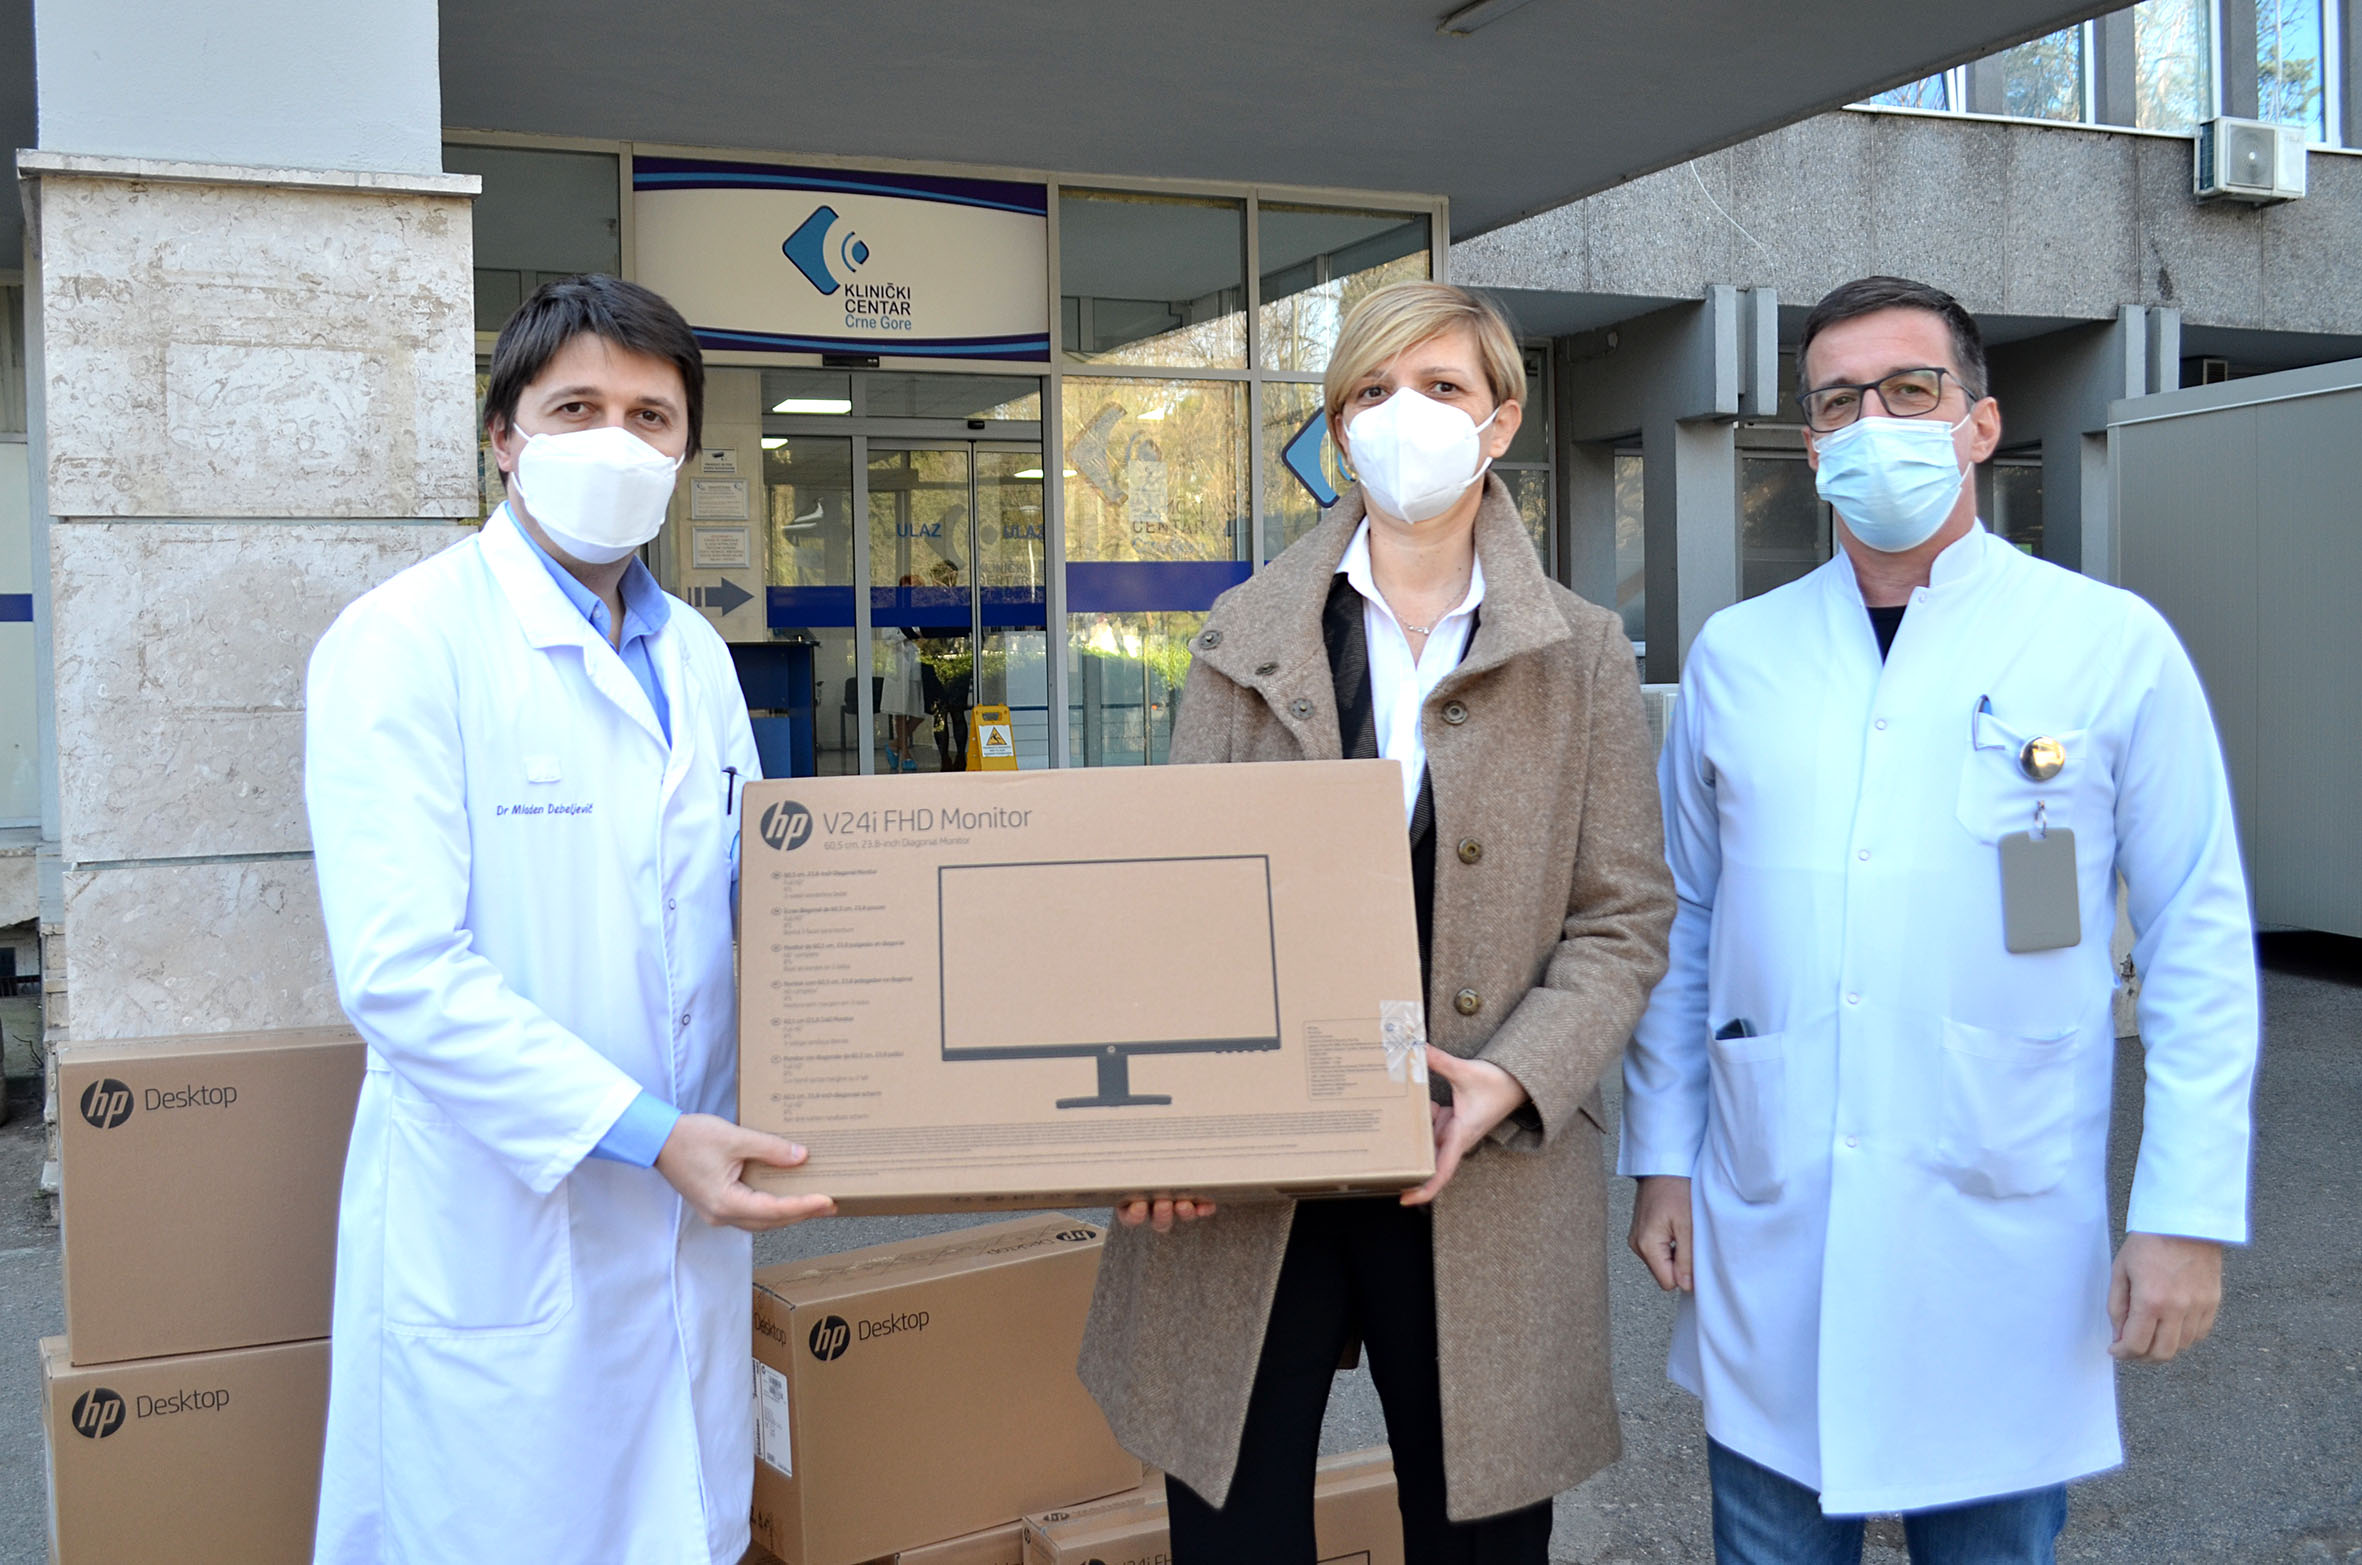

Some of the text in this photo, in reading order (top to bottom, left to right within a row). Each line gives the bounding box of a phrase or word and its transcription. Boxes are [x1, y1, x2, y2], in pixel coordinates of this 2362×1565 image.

[844, 282, 911, 300] KLINIČKI
[844, 299, 911, 315] CENTAR
[845, 314, 912, 330] Crne Gore
[896, 523, 942, 538] ULAZ
[497, 805, 509, 816] Dr
[760, 800, 1033, 851] hp V24i FHD Monitor
[80, 1078, 238, 1129] hp Desktop
[809, 1311, 930, 1361] hp Desktop
[72, 1387, 230, 1439] hp Desktop
